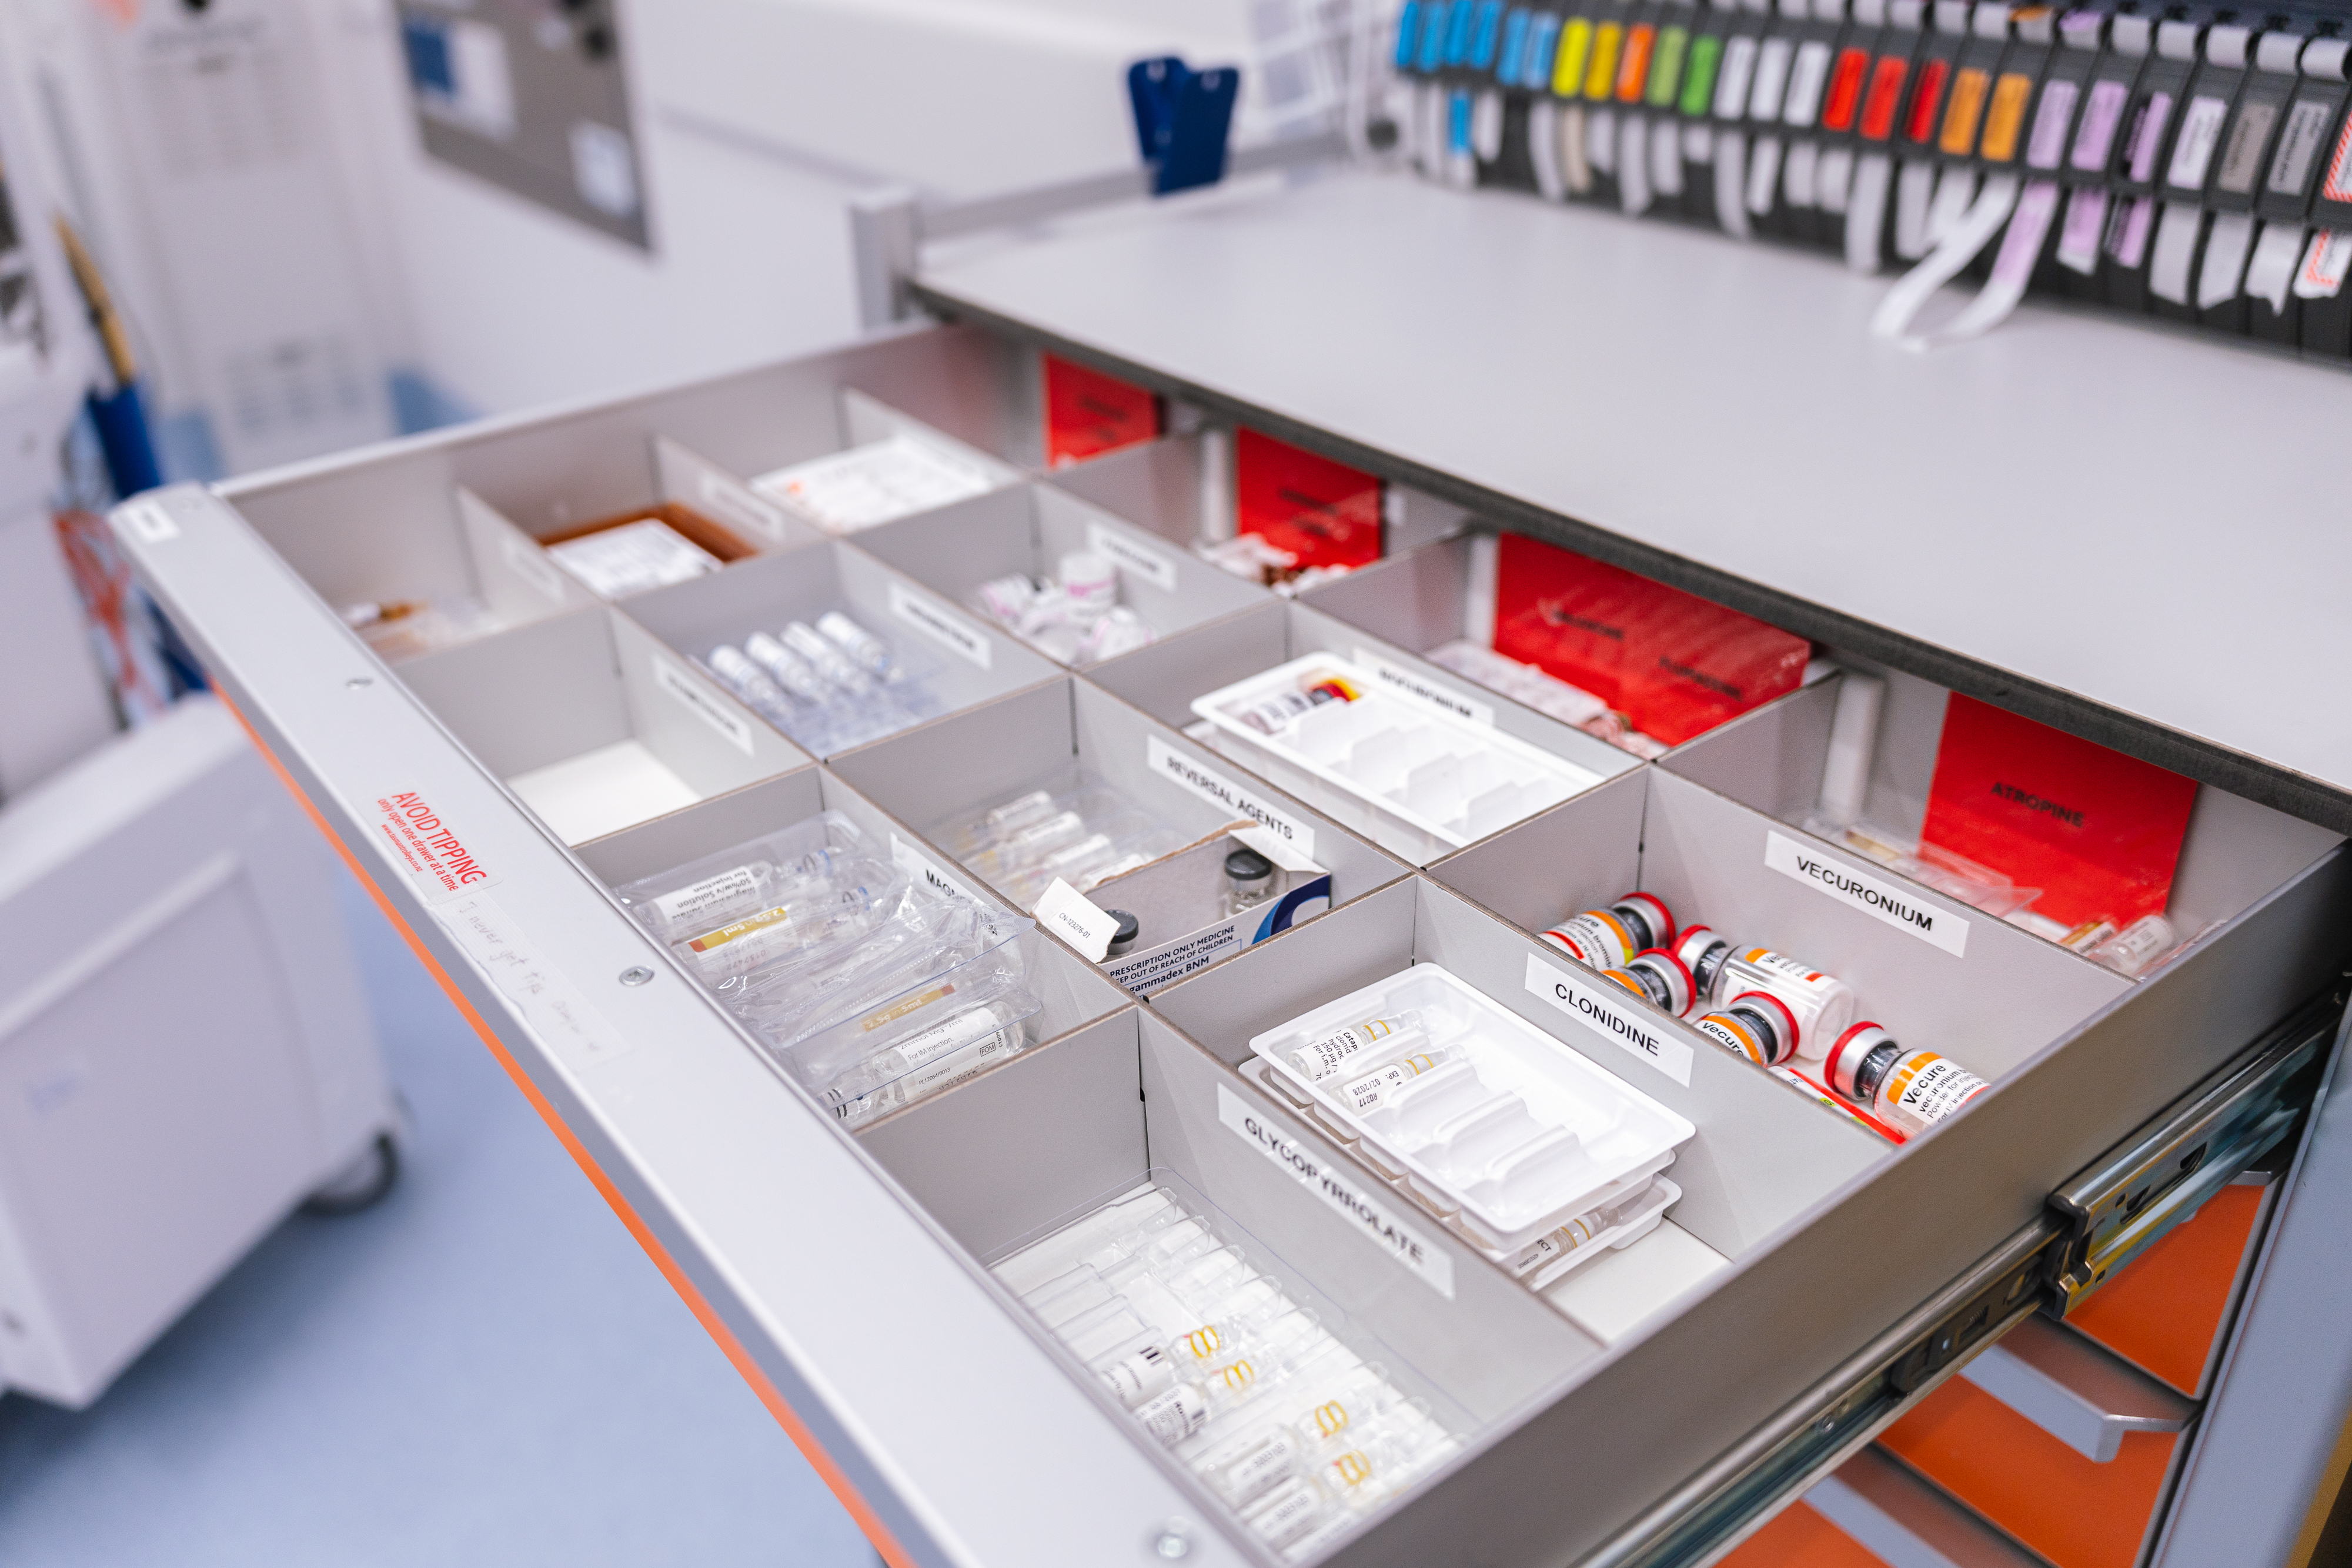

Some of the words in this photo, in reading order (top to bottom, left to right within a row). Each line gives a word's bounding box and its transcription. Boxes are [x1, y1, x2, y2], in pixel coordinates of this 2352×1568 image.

[1167, 755, 1233, 806] REVERSAL
[1238, 799, 1293, 840] AGENTS
[1990, 781, 2086, 828] ATROPINE
[377, 798, 396, 813] only
[388, 812, 407, 828] open
[402, 827, 417, 841] one
[412, 840, 436, 862] drawer
[430, 862, 444, 871] at
[440, 874, 459, 891] time
[381, 824, 423, 872] www.tasmantrolleys.co.nz
[392, 791, 441, 831] AVOID
[426, 828, 487, 885] TIPPING
[677, 891, 716, 908] Solution
[1797, 855, 1933, 932] VECURONIUM
[723, 923, 746, 936] 5ml
[1058, 912, 1091, 940] CN-123276-01
[1110, 951, 1171, 978] PRESCRIPTION
[1172, 941, 1195, 957] ONLY
[1197, 925, 1235, 947] MEDICINE
[1130, 971, 1147, 983] OUT
[1148, 965, 1160, 974] OF
[1161, 955, 1185, 969] REACH
[1186, 950, 1196, 958] OF
[1198, 934, 1233, 954] CHILDREN
[1130, 968, 1184, 995] gammadex
[1185, 956, 1210, 972] BNM
[1554, 982, 1659, 1057] CLONIDINE
[908, 1050, 919, 1061] For
[918, 1046, 928, 1057] IM
[927, 1037, 954, 1054] injection.
[981, 1044, 995, 1055] POM
[1313, 1045, 1323, 1055] For
[1321, 1042, 1333, 1053] 150
[918, 1067, 951, 1085] PL12064/0013
[1352, 1078, 1381, 1096] 02/2028
[1385, 1070, 1399, 1079] EXP:
[1903, 1064, 1946, 1105] Vecure
[1919, 1068, 1962, 1113] vecuronium
[1952, 1082, 1977, 1105] injection
[1926, 1088, 1949, 1119] Powder
[1948, 1081, 1959, 1091] for
[1244, 1117, 1425, 1263] GLYCOPYRROLATE
